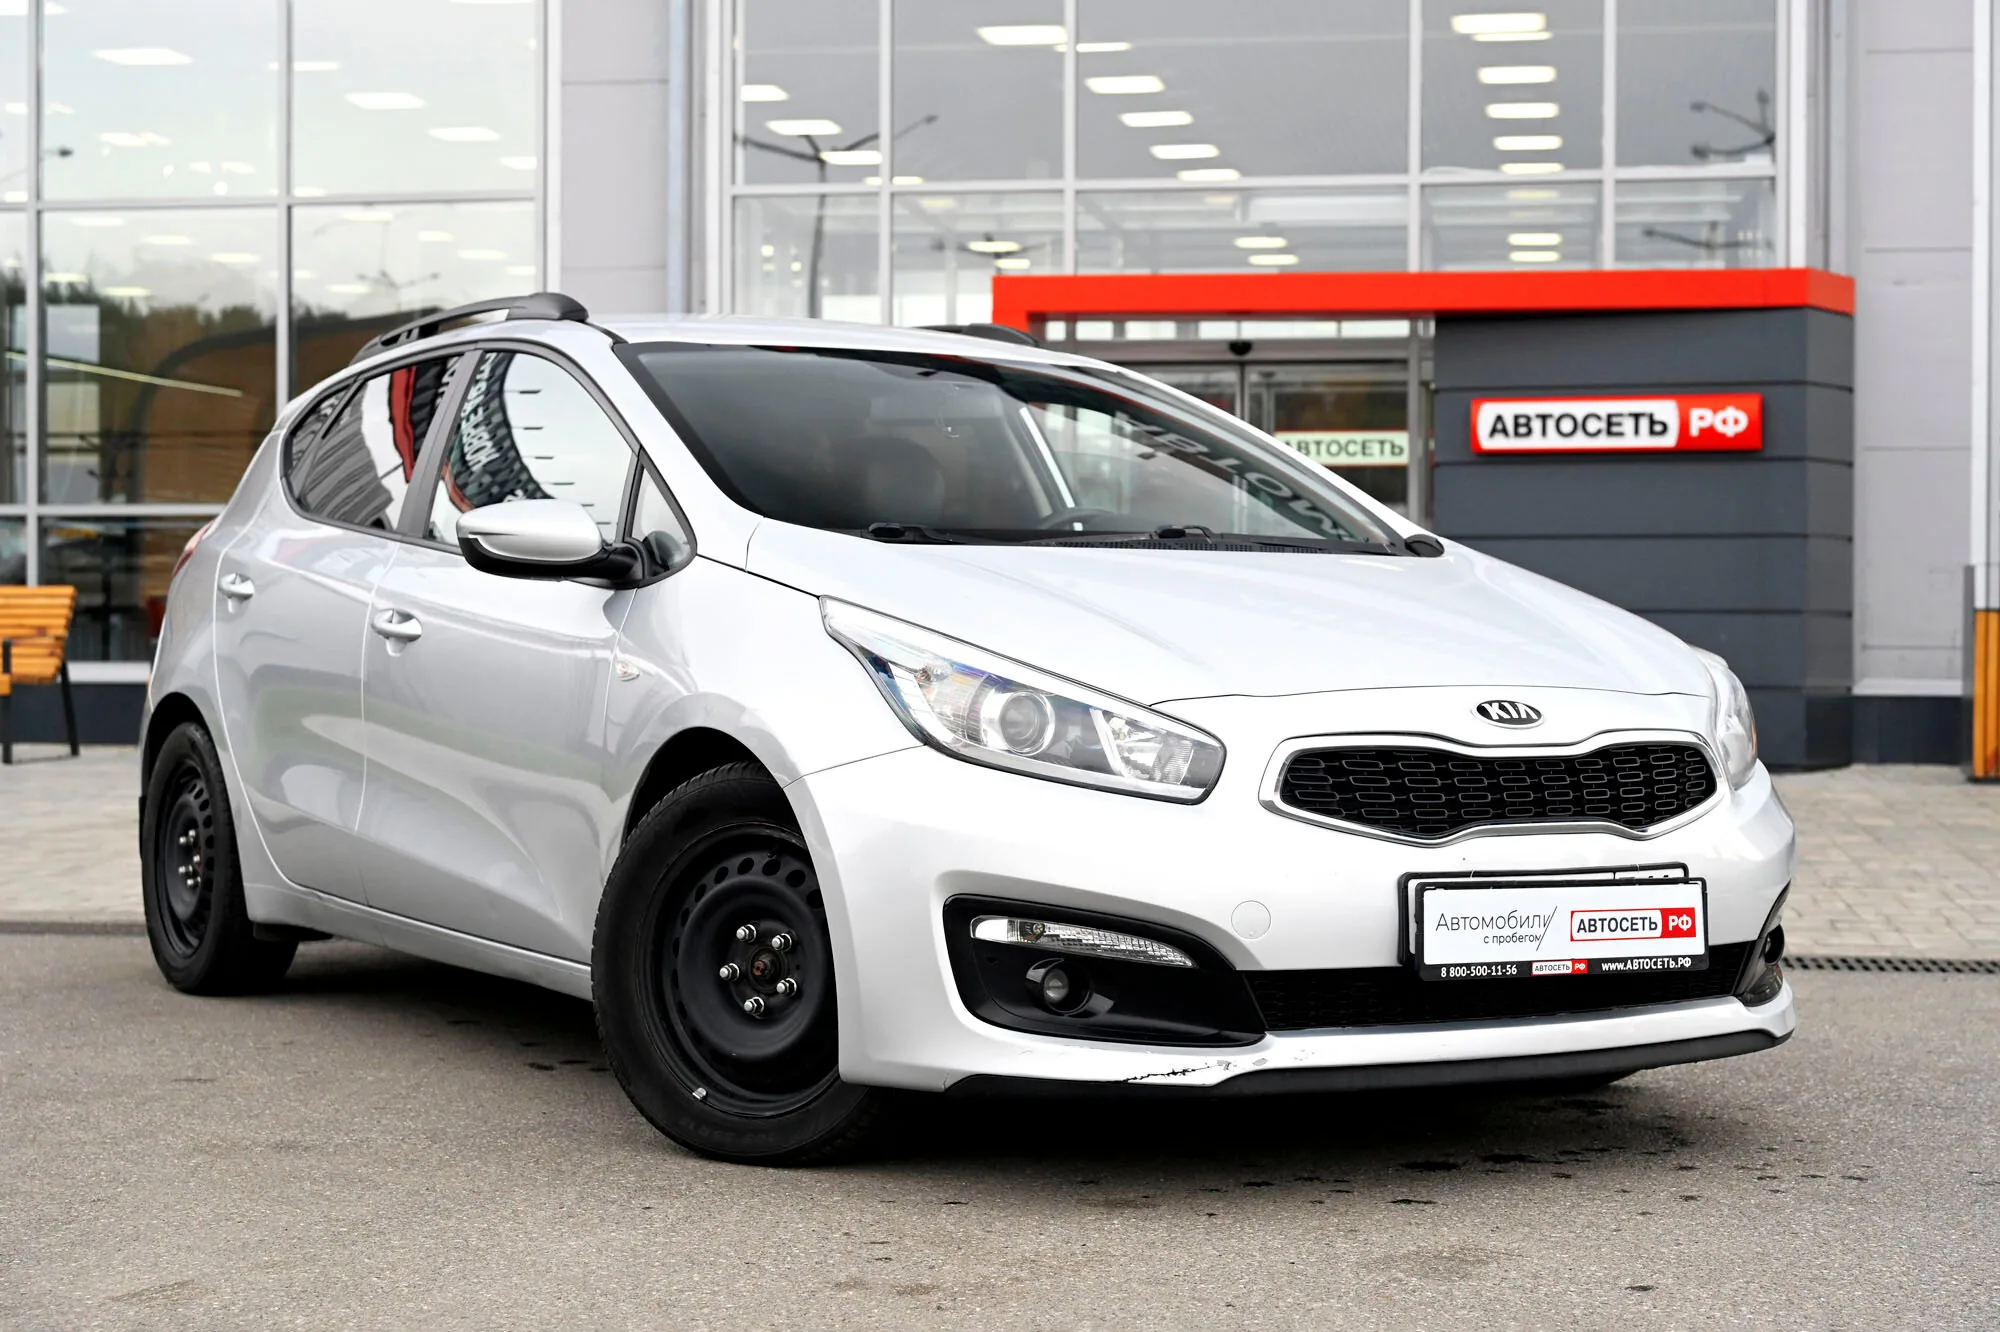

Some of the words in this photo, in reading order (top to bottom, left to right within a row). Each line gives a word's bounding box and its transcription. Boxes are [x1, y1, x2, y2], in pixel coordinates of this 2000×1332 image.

[1489, 412, 1669, 438] АВТОСЕТЬ
[1689, 406, 1749, 437] РФ
[1481, 702, 1539, 720] KIA
[1436, 910, 1551, 932] Автомобили
[1576, 916, 1658, 934] АВТОСЕТЬ
[1668, 914, 1692, 931] РФ
[1483, 935, 1490, 944] с
[1492, 932, 1542, 946] пробегом
[1440, 966, 1447, 977] 8
[1449, 964, 1518, 977] 800-500-11-56
[1534, 963, 1570, 972] АВТОСЕТЬ
[1574, 962, 1586, 971] РФ
[1601, 957, 1692, 972] www.АВТОСЕТЬ.РФ
